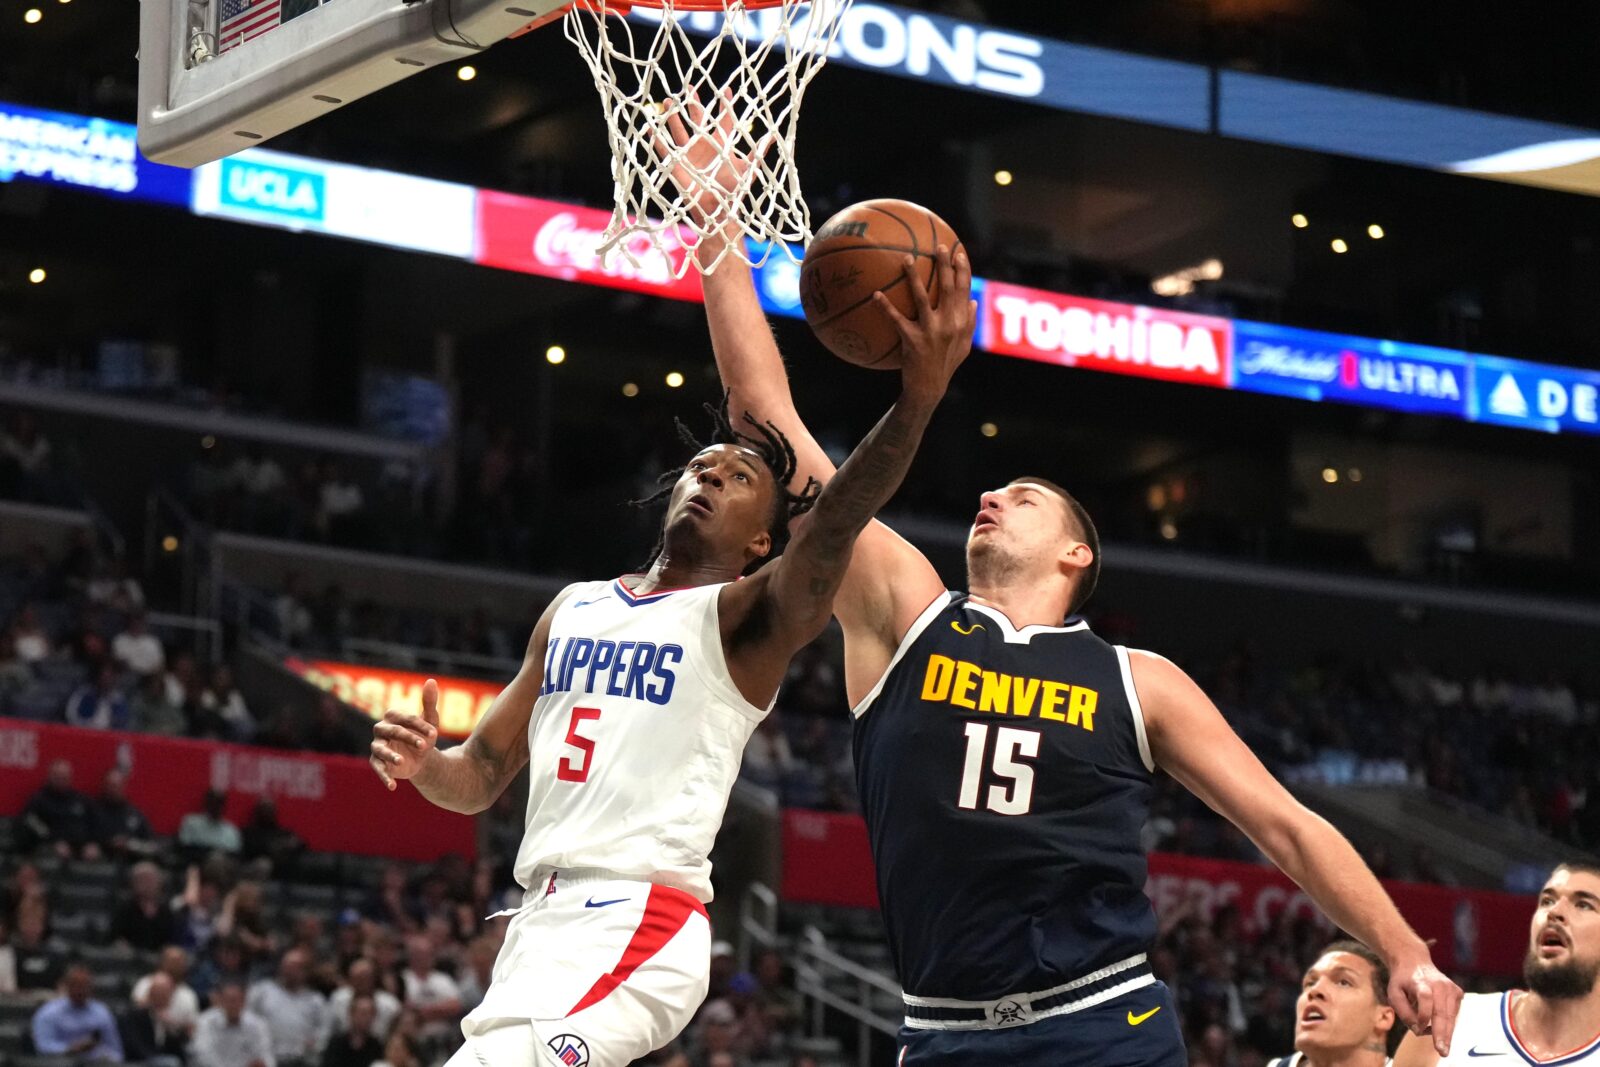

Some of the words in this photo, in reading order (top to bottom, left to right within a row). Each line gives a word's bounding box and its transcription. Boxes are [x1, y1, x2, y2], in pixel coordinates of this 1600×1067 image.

[228, 164, 319, 214] UCLA
[995, 295, 1220, 374] TOSHIBA
[1359, 357, 1460, 400] ULTRA
[540, 637, 683, 705] LIPPERS
[921, 654, 1098, 732] DENVER
[557, 707, 601, 782] 5
[958, 722, 1041, 816] 15
